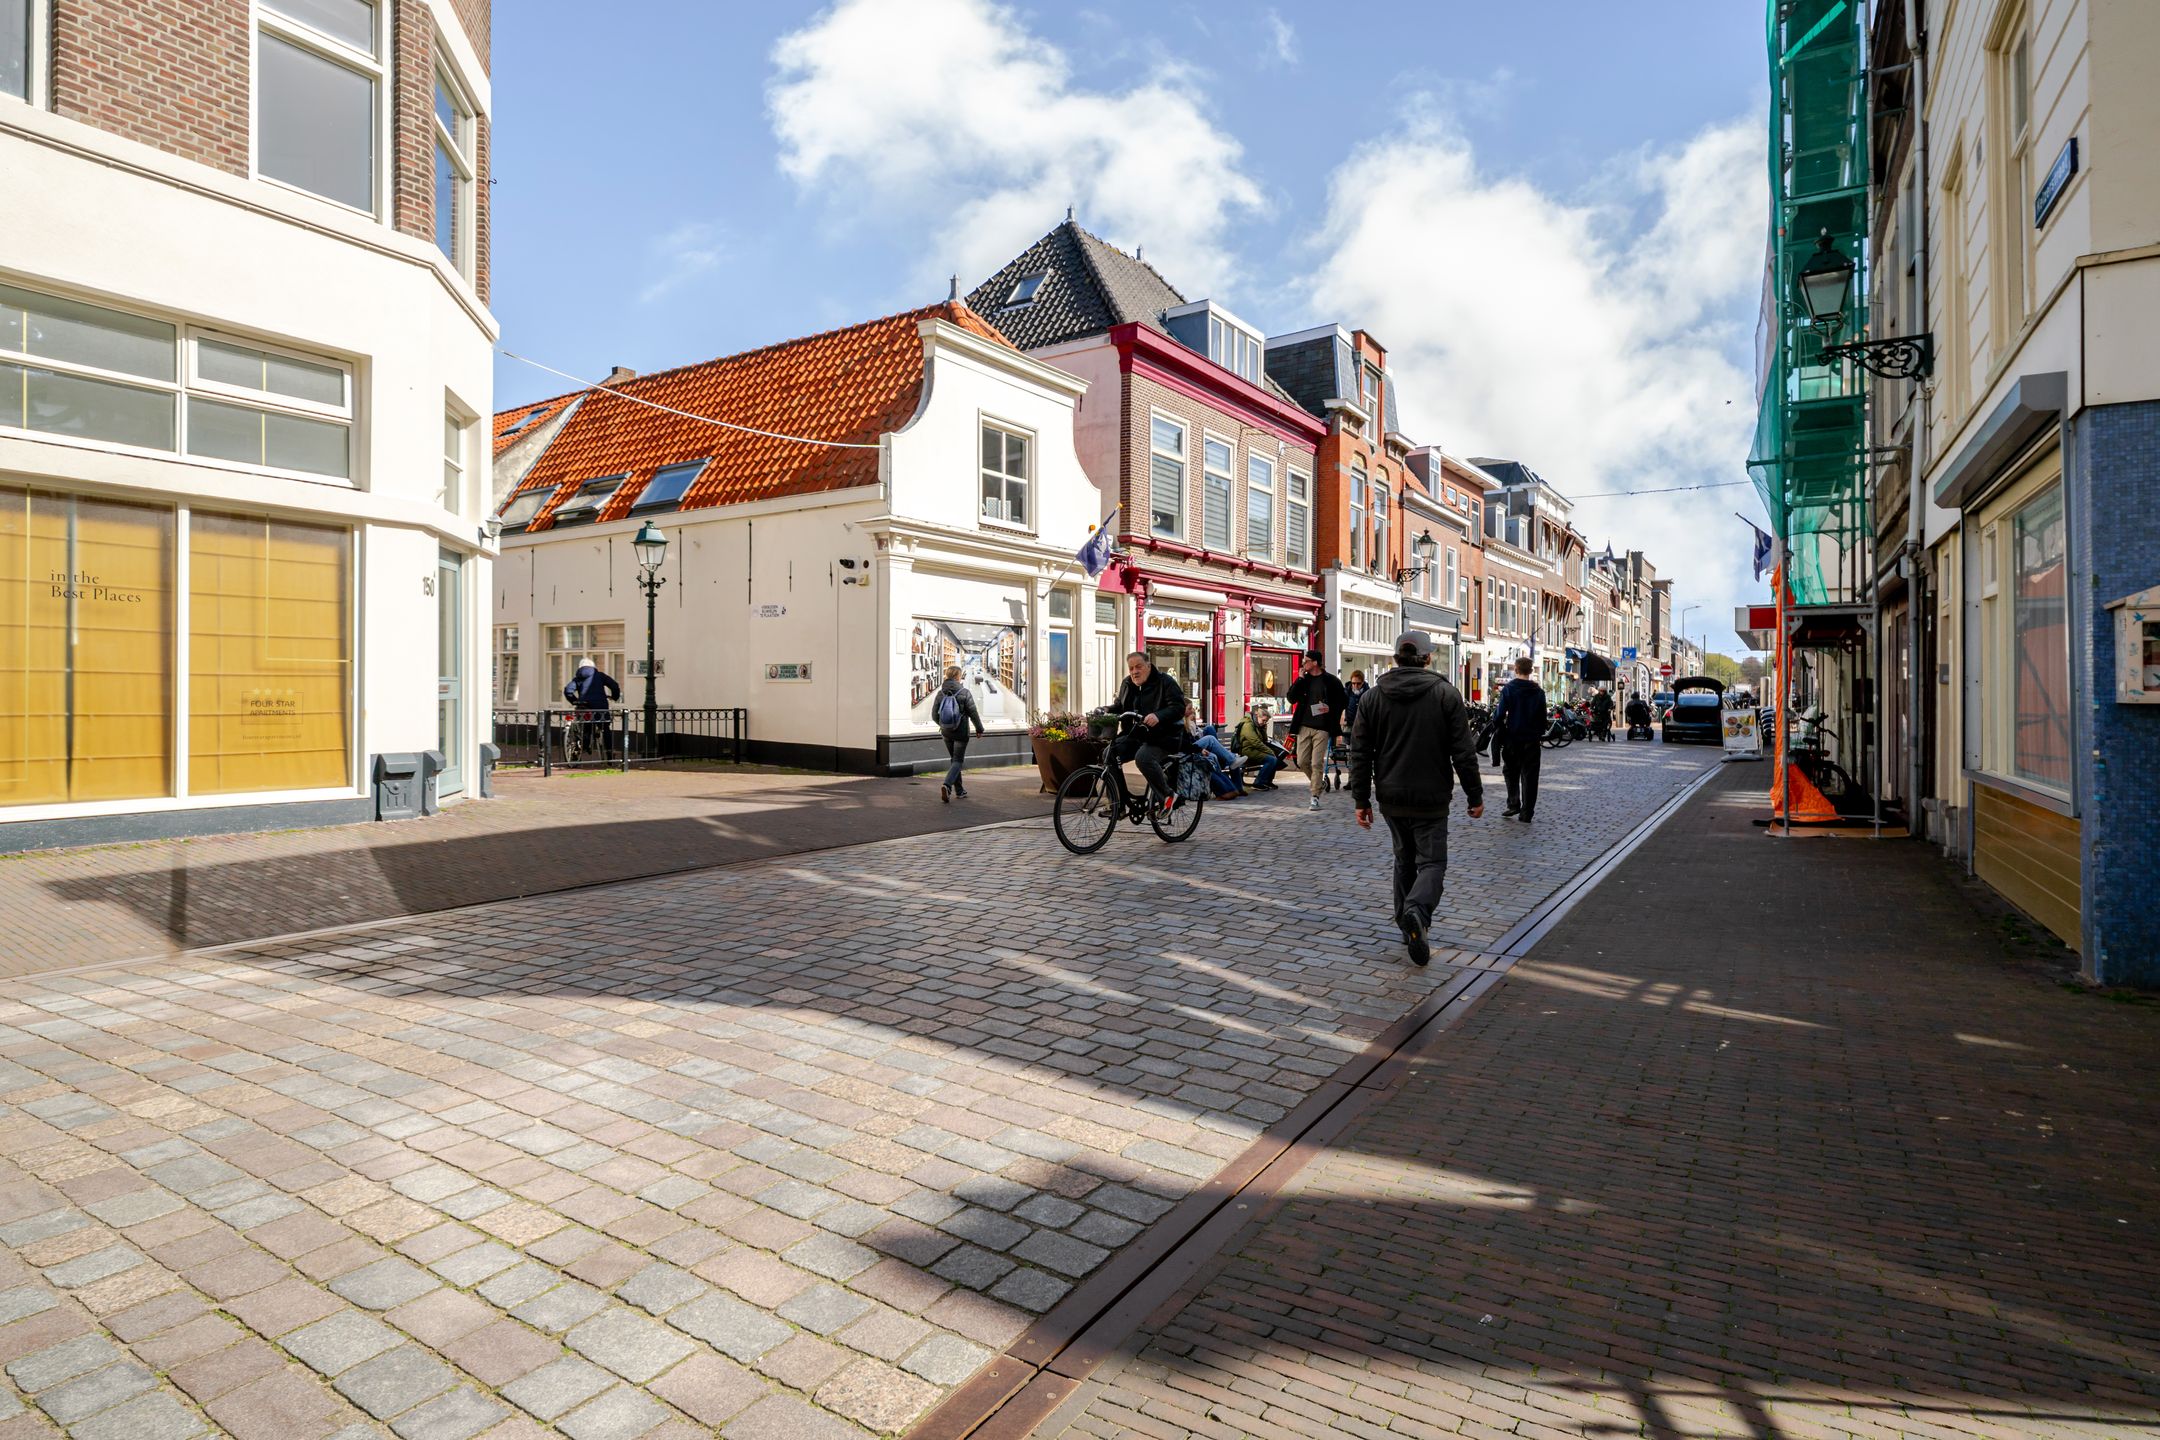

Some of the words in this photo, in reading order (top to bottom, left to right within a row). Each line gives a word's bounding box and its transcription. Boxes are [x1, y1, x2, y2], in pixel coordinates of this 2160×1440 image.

[51, 569, 66, 582] in
[74, 570, 100, 584] the
[51, 585, 86, 600] Best
[93, 588, 142, 603] Places
[1147, 615, 1162, 631] City
[1172, 618, 1196, 633] Angels
